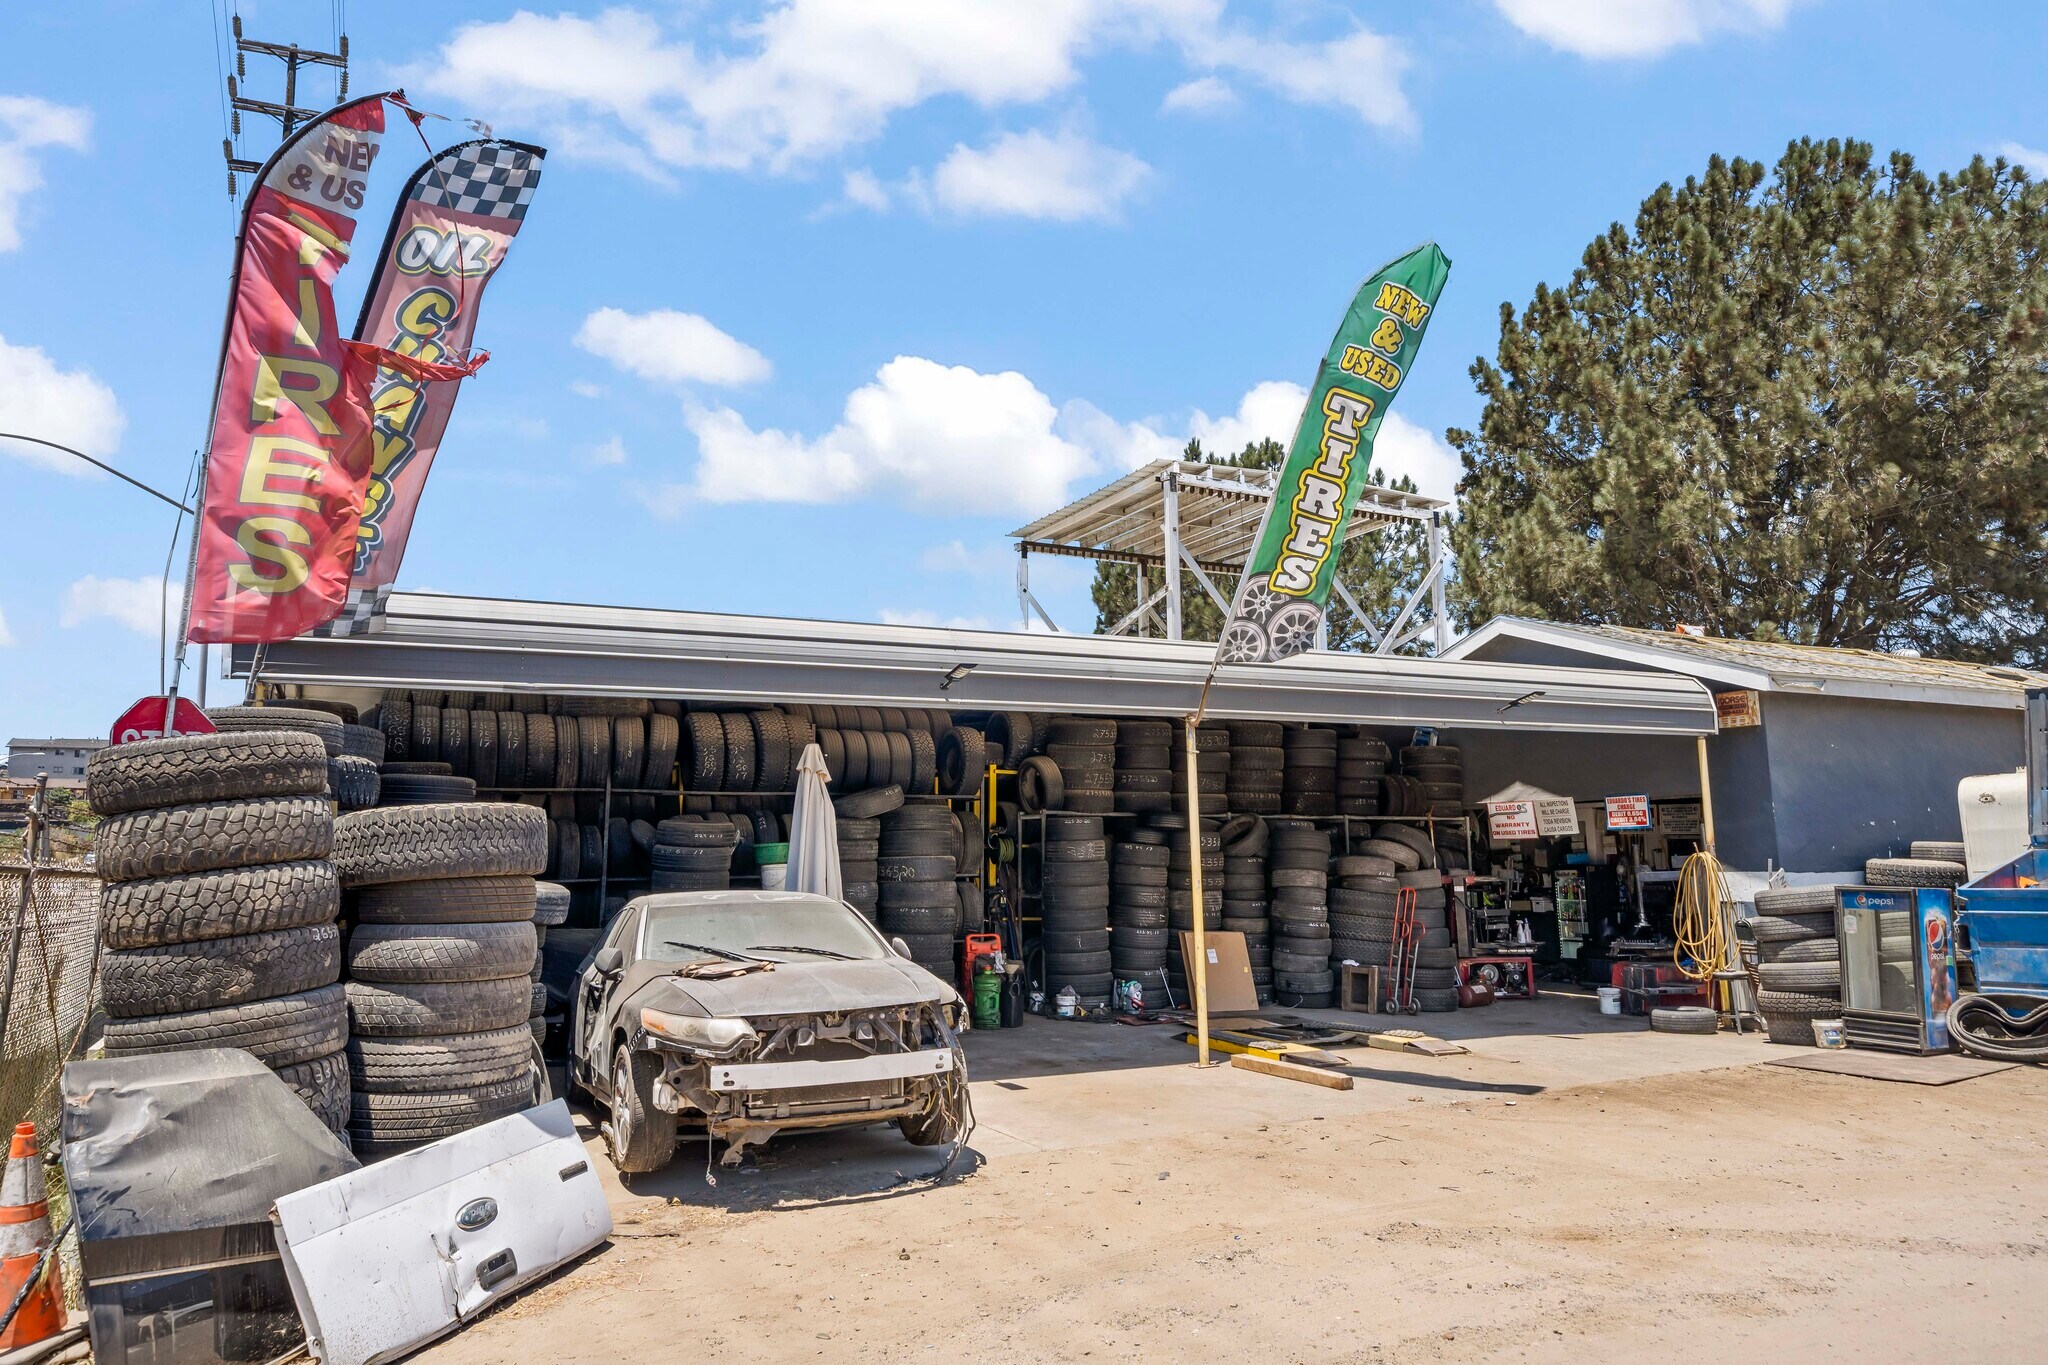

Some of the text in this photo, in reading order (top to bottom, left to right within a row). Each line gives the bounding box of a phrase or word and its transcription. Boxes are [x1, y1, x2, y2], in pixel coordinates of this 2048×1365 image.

[287, 164, 313, 192] &
[397, 226, 491, 276] OIL
[1375, 282, 1430, 329] NEW
[1371, 318, 1403, 355] &
[1341, 344, 1402, 391] USED
[1269, 388, 1373, 596] TIRES
[1868, 897, 1894, 906] pepsi
